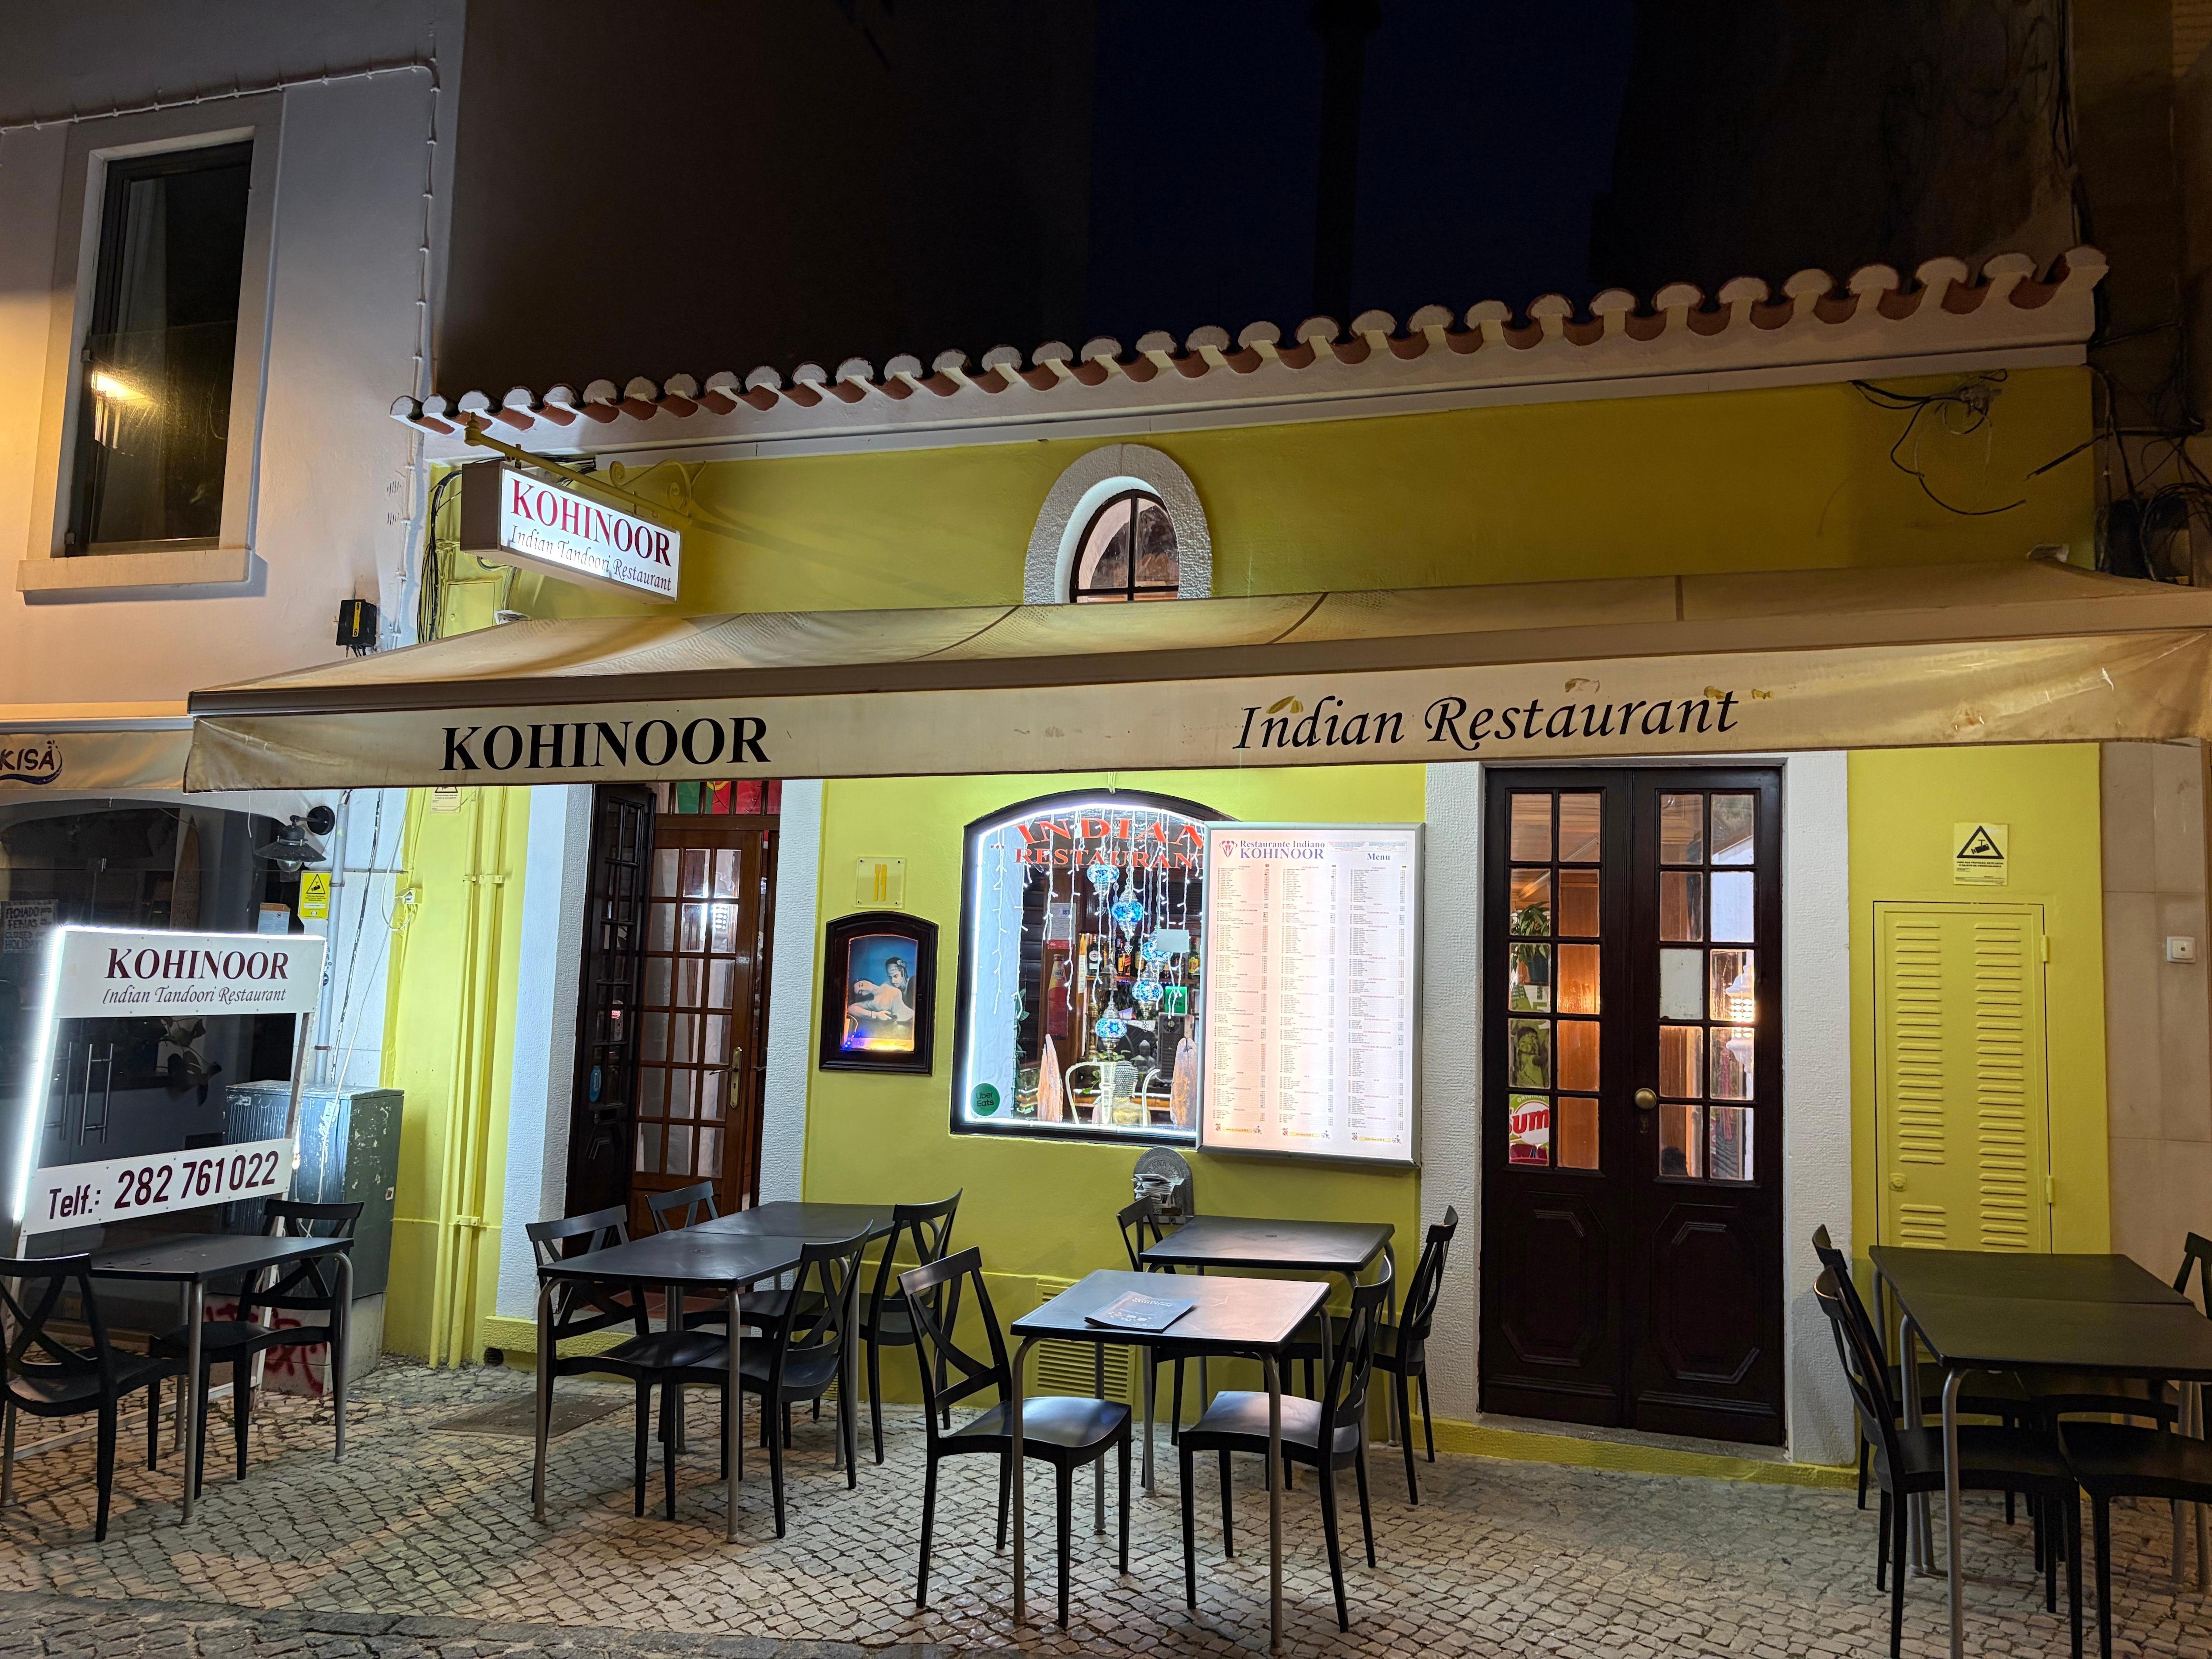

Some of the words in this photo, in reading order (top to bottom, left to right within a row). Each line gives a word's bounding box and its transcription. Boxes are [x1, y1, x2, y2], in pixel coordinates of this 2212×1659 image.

[511, 478, 671, 567] KOHINOOR
[511, 525, 553, 554] Indian
[558, 541, 610, 572] Tandoori
[613, 559, 672, 591] Restaurant
[1233, 695, 1404, 749] Indian
[1425, 691, 1739, 751] Restaurant
[439, 717, 771, 770] KOHINOOR
[1014, 818, 1203, 850] INDIAN
[1240, 848, 1324, 859] KOHINOOR
[104, 948, 288, 979] KOHINOOR
[102, 985, 150, 1004] Indian
[155, 985, 216, 1003] Tandoori
[219, 987, 287, 1005] Restaurant
[114, 1165, 173, 1209] 282
